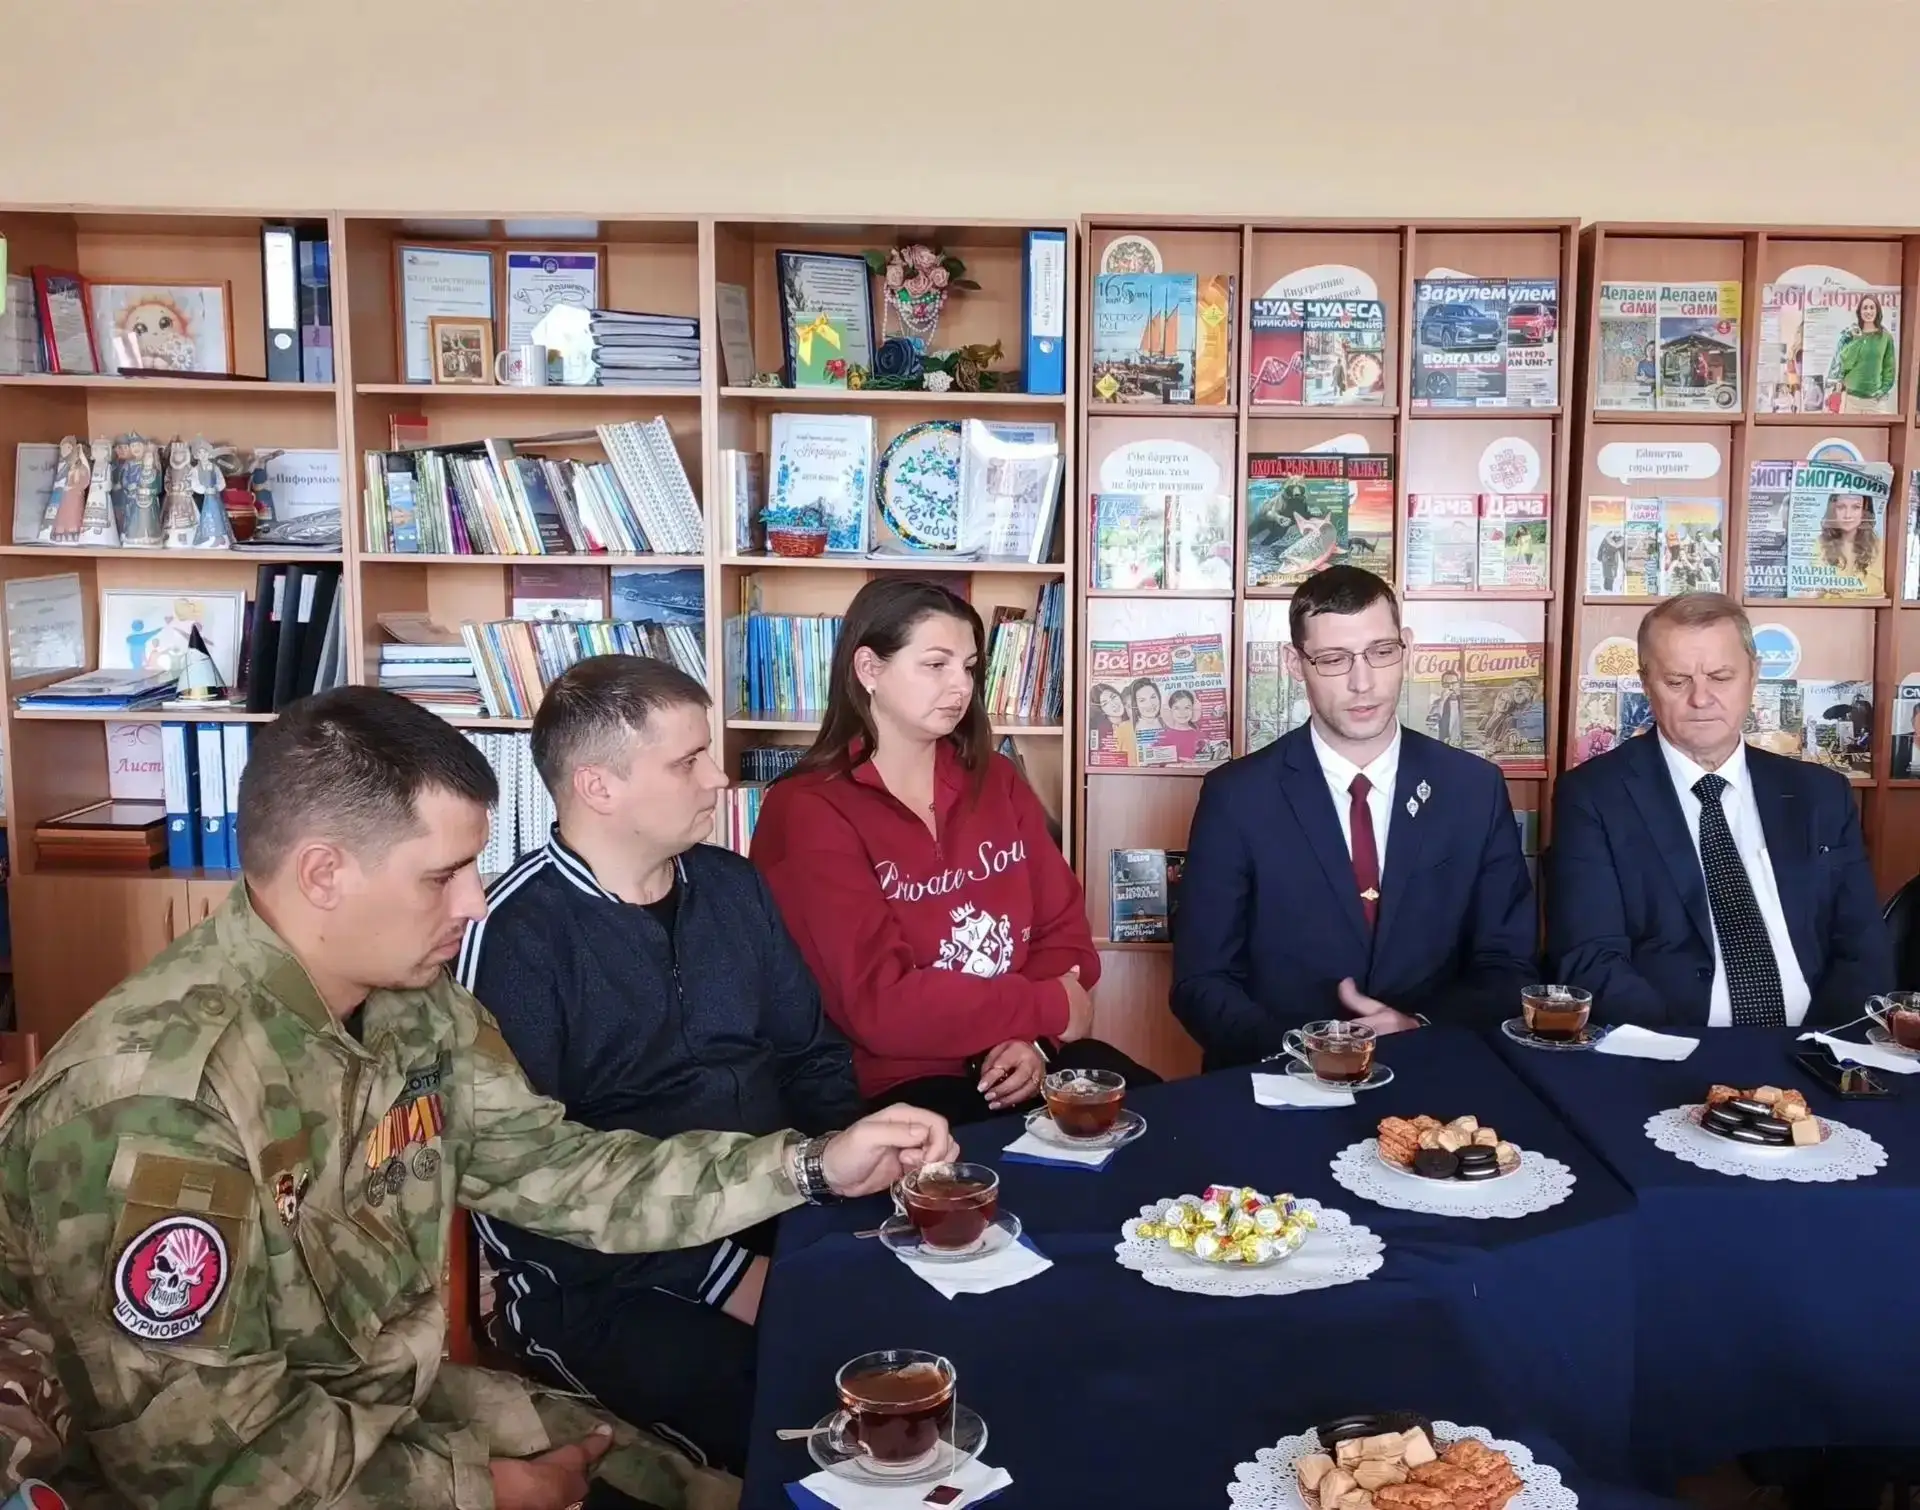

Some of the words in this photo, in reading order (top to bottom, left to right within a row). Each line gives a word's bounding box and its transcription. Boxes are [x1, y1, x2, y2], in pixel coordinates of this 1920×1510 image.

[1600, 285, 1657, 301] Делаем
[1660, 287, 1718, 302] Делаем
[1307, 302, 1382, 318] ЧУДЕСА
[1620, 302, 1657, 314] сами
[1681, 305, 1718, 316] сами
[1307, 320, 1383, 330] ПРИКЛЮЧЕНИЯ
[1285, 459, 1338, 476] РЫБАЛКА
[1795, 468, 1889, 496] БИОГРАФИЯ
[1488, 495, 1544, 518] Дача
[1791, 564, 1836, 576] МАРИЯ
[1791, 576, 1863, 587] МИРОНОВА
[1185, 679, 1222, 689] тревоги
[874, 859, 965, 902] Private
